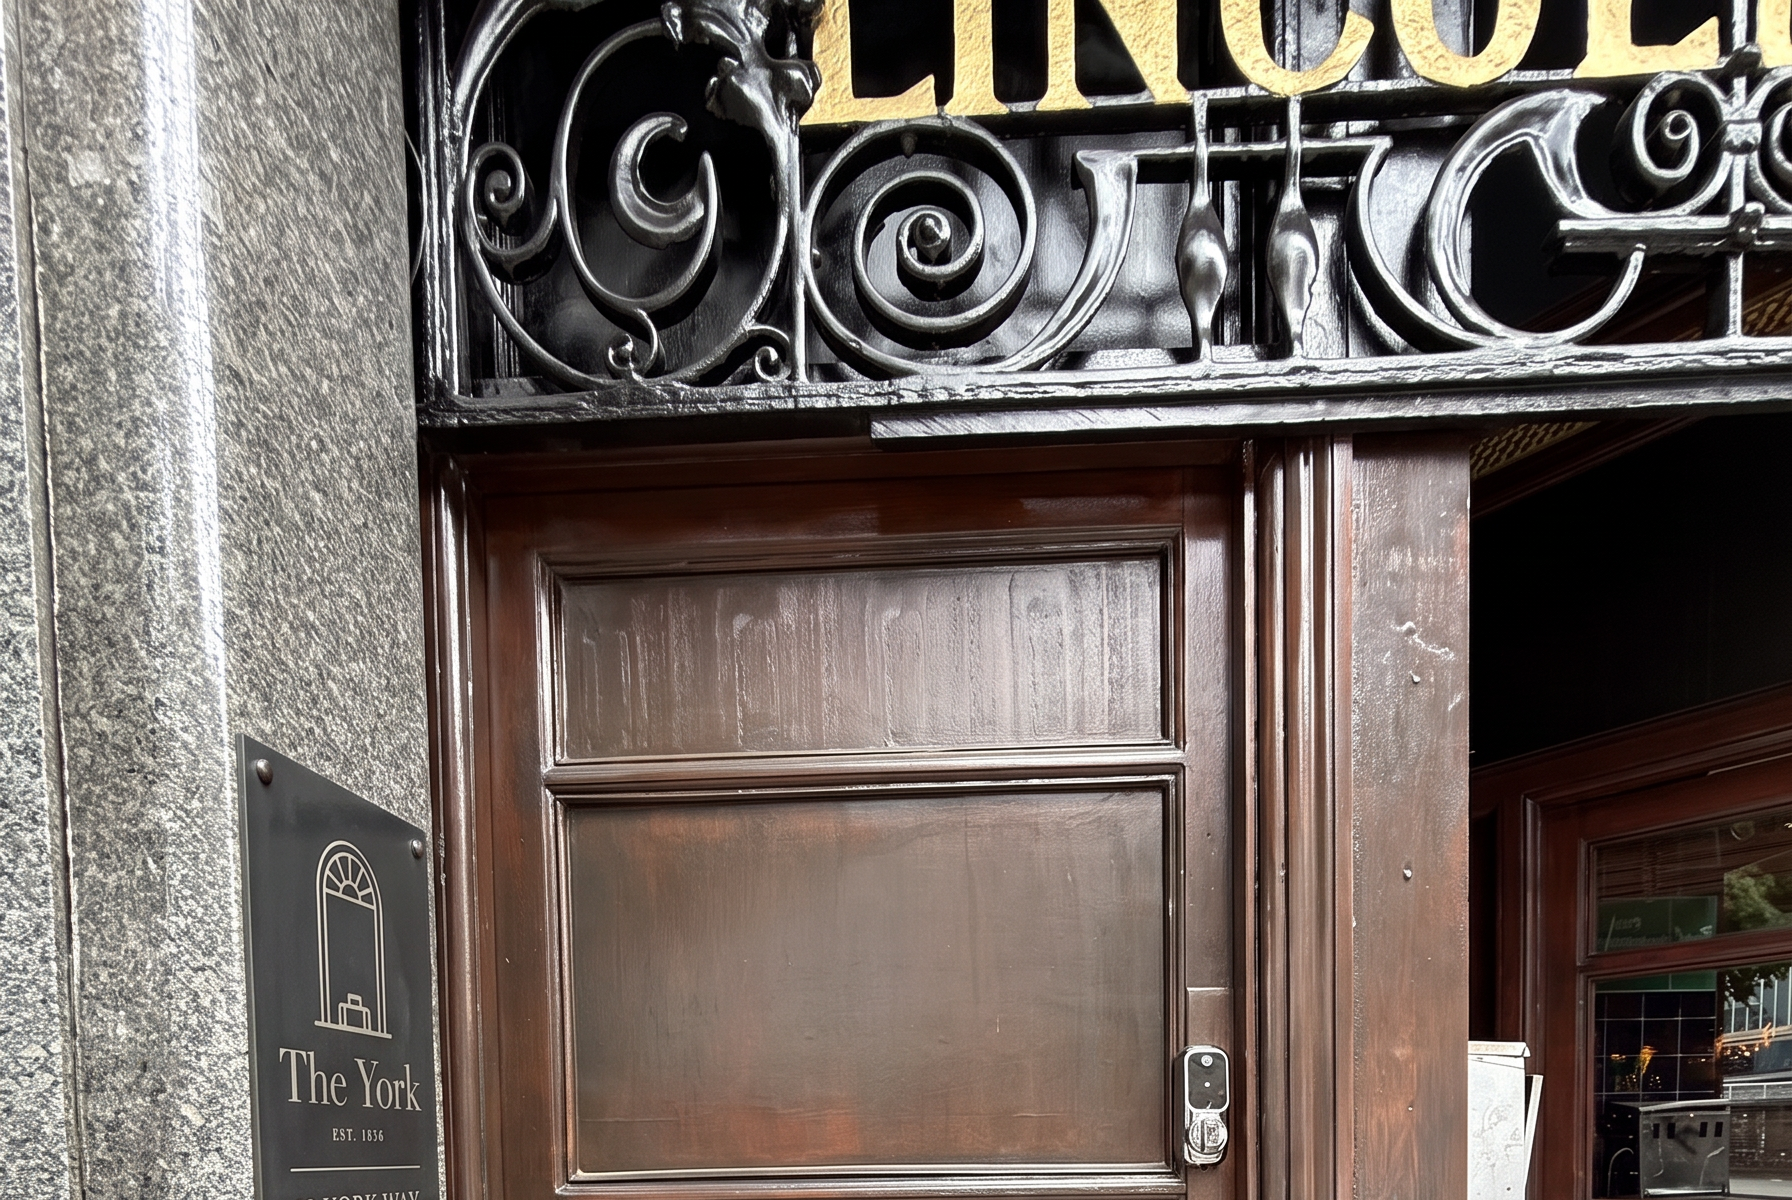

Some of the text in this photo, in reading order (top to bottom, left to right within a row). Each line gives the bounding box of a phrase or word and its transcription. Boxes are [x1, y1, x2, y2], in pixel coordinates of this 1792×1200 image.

[799, 0, 1792, 125] LINCOL
[279, 1047, 422, 1112] The York
[332, 1127, 384, 1142] EST. 1836
